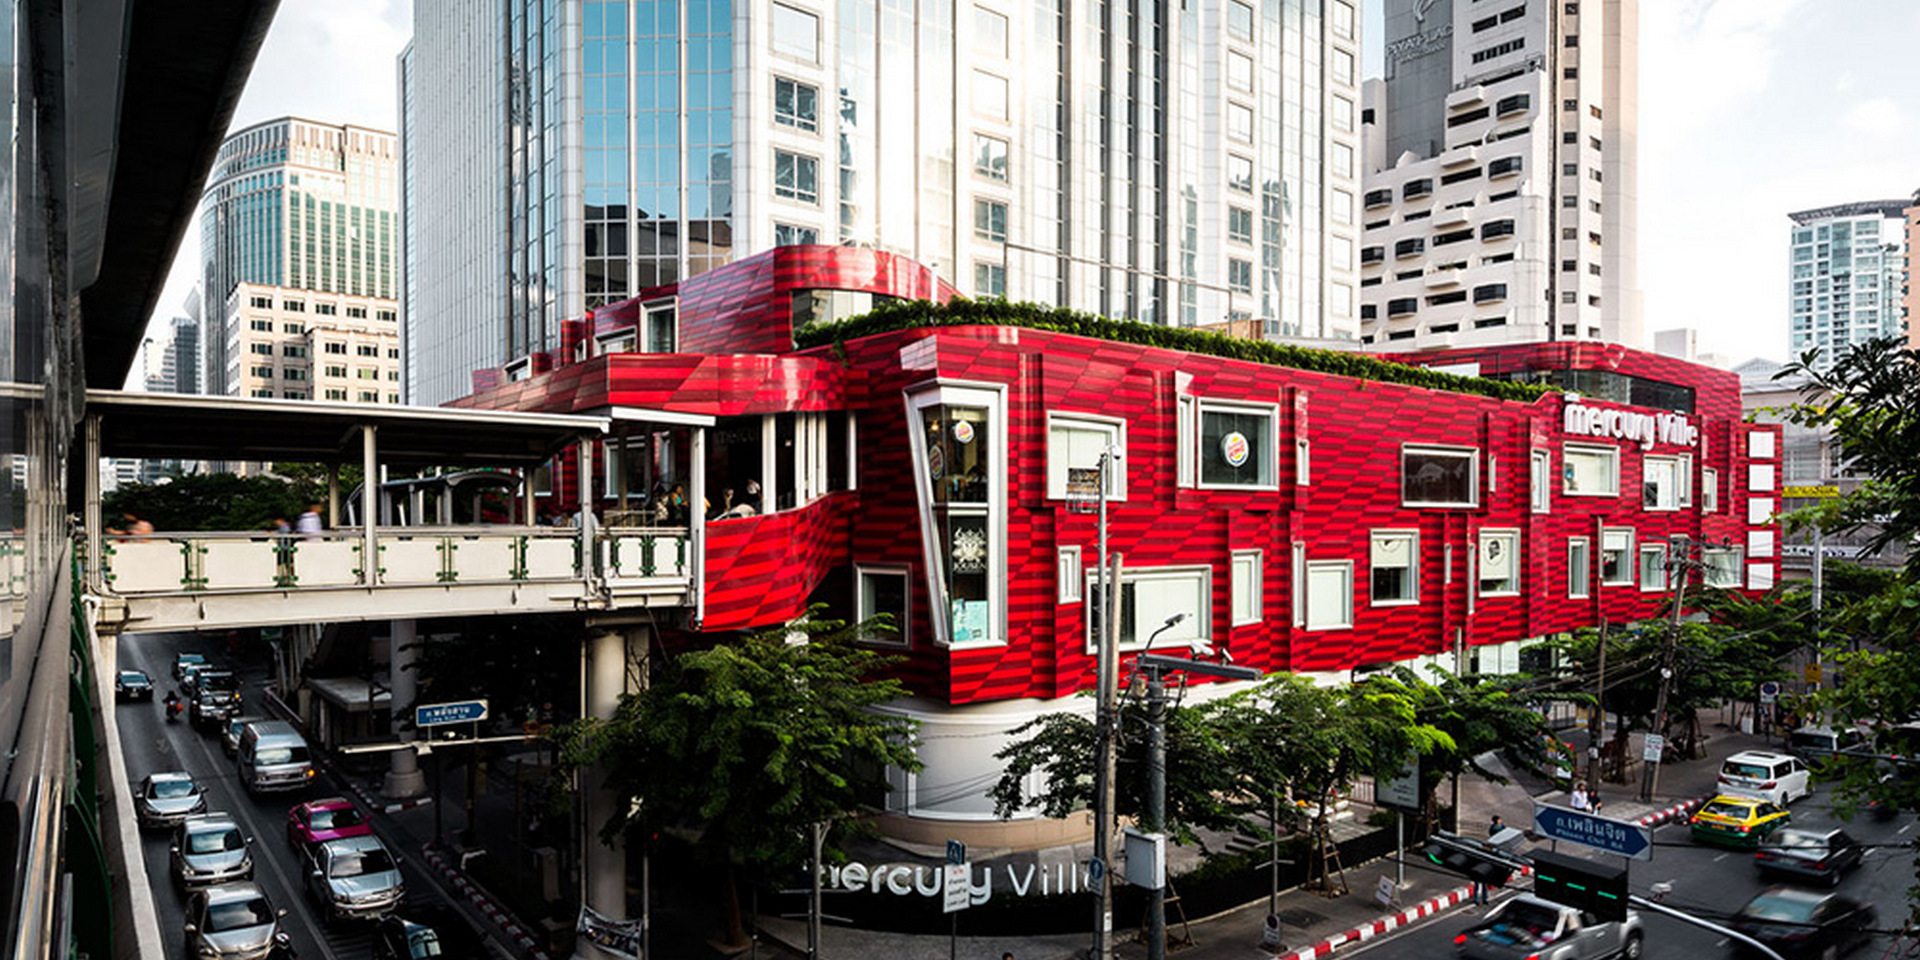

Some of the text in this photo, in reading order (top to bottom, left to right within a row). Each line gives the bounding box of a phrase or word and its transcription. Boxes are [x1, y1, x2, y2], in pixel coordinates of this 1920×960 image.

[1564, 404, 1698, 450] mercury Ville
[803, 861, 991, 906] ercuy
[1007, 862, 1092, 897] Vill
